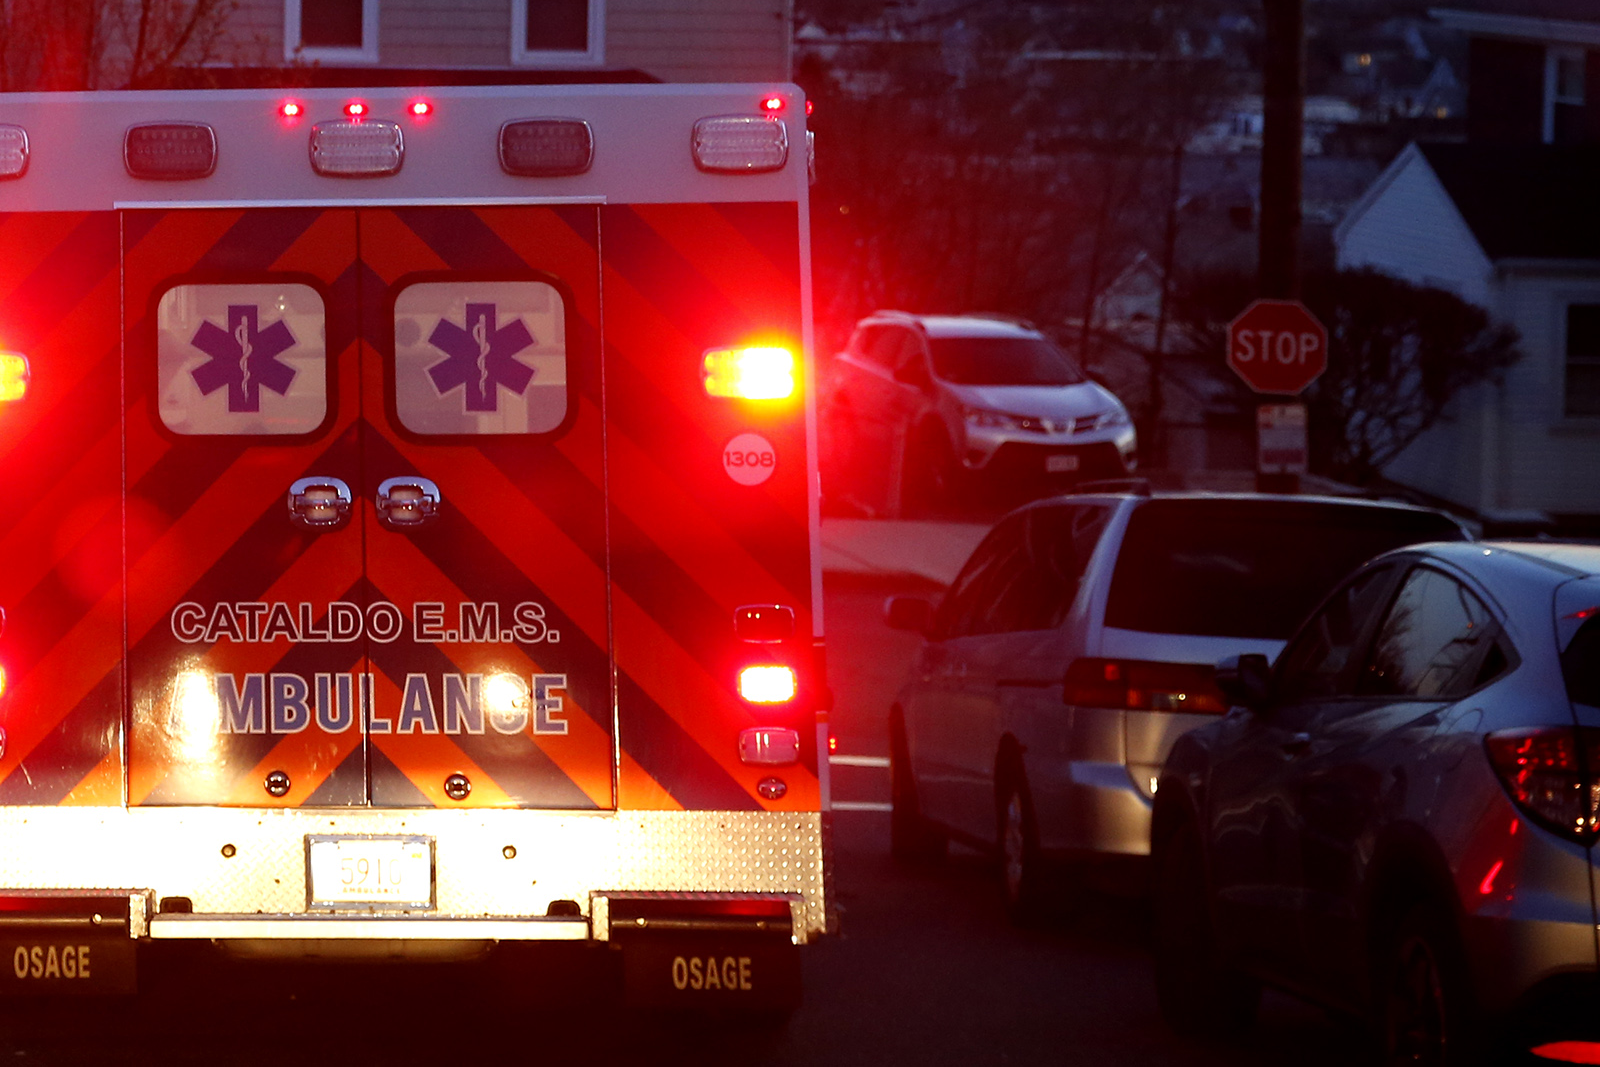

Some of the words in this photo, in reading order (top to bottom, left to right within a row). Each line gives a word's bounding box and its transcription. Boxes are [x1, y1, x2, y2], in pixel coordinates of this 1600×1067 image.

[1235, 329, 1319, 365] STOP
[724, 451, 774, 468] 1308
[170, 602, 402, 643] CATALDO
[413, 602, 560, 643] E.M.S.
[13, 945, 91, 979] OSAGE
[671, 956, 753, 990] OSAGE
